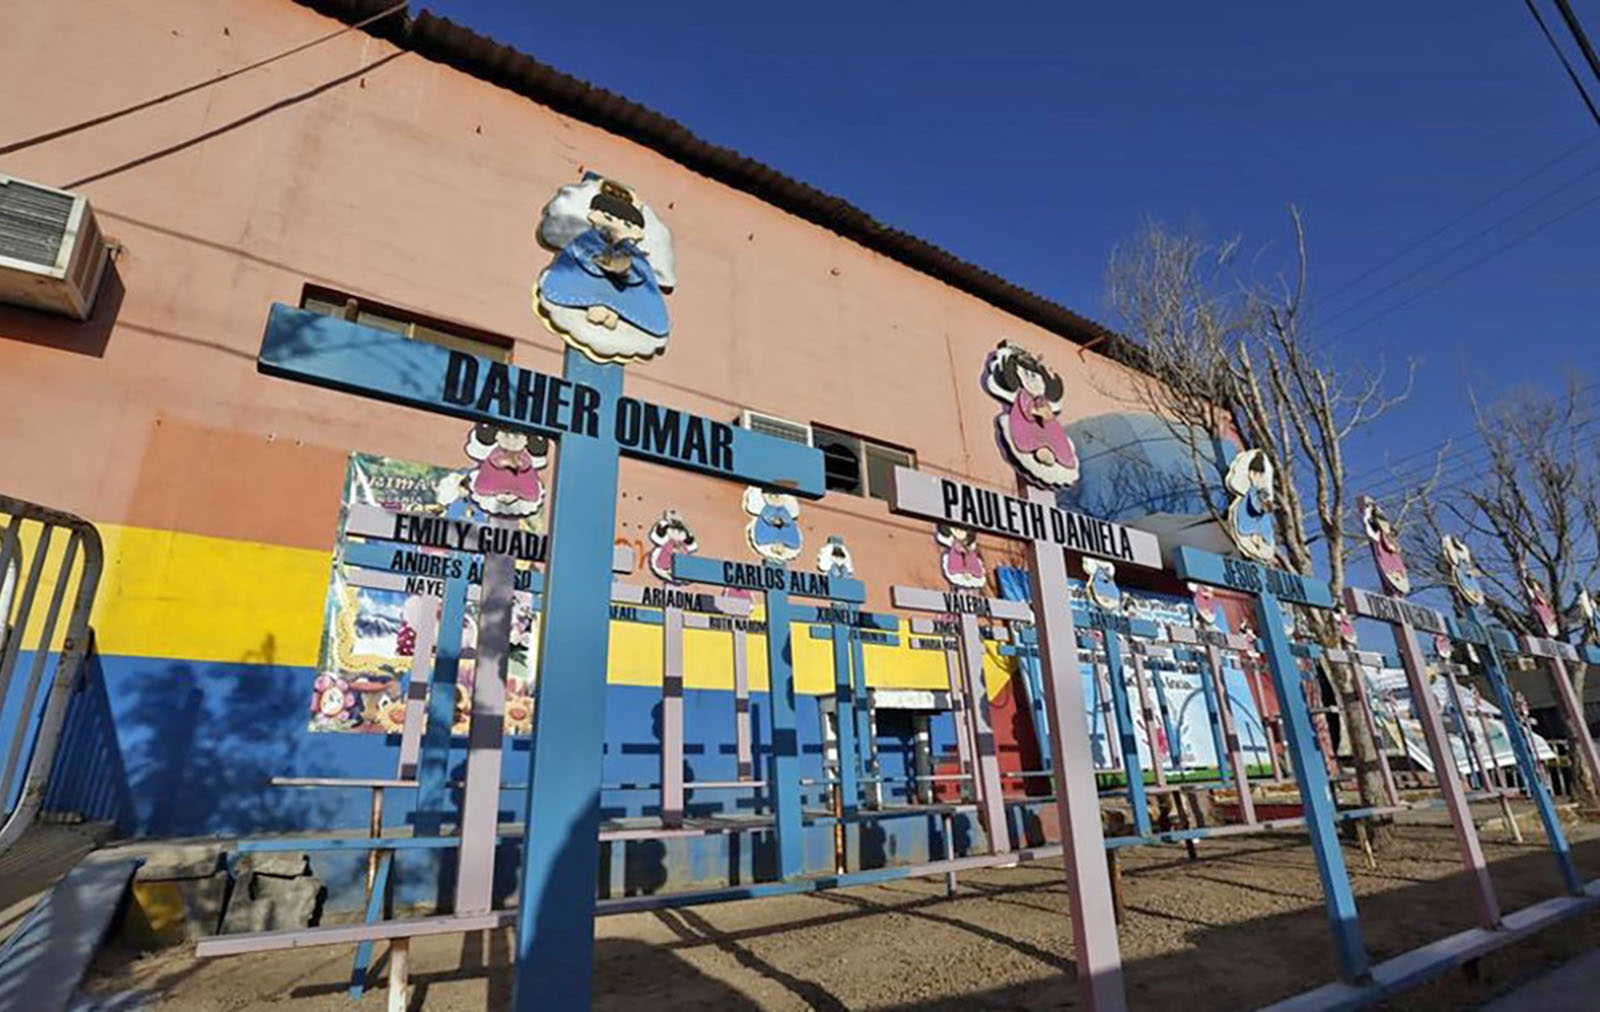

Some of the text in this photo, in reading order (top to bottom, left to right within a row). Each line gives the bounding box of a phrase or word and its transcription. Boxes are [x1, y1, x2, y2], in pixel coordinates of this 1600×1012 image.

[443, 350, 734, 471] DAHER OMAR
[393, 513, 473, 550] EMILY
[941, 479, 1135, 561] PAULETH DANIELA
[391, 550, 463, 579] ANDRES
[723, 560, 830, 597] CARLOS ALAN
[1223, 558, 1263, 592] JESUS
[405, 576, 444, 598] NAYE
[642, 586, 703, 612] ARIADNA
[943, 592, 992, 616] VALERIA
